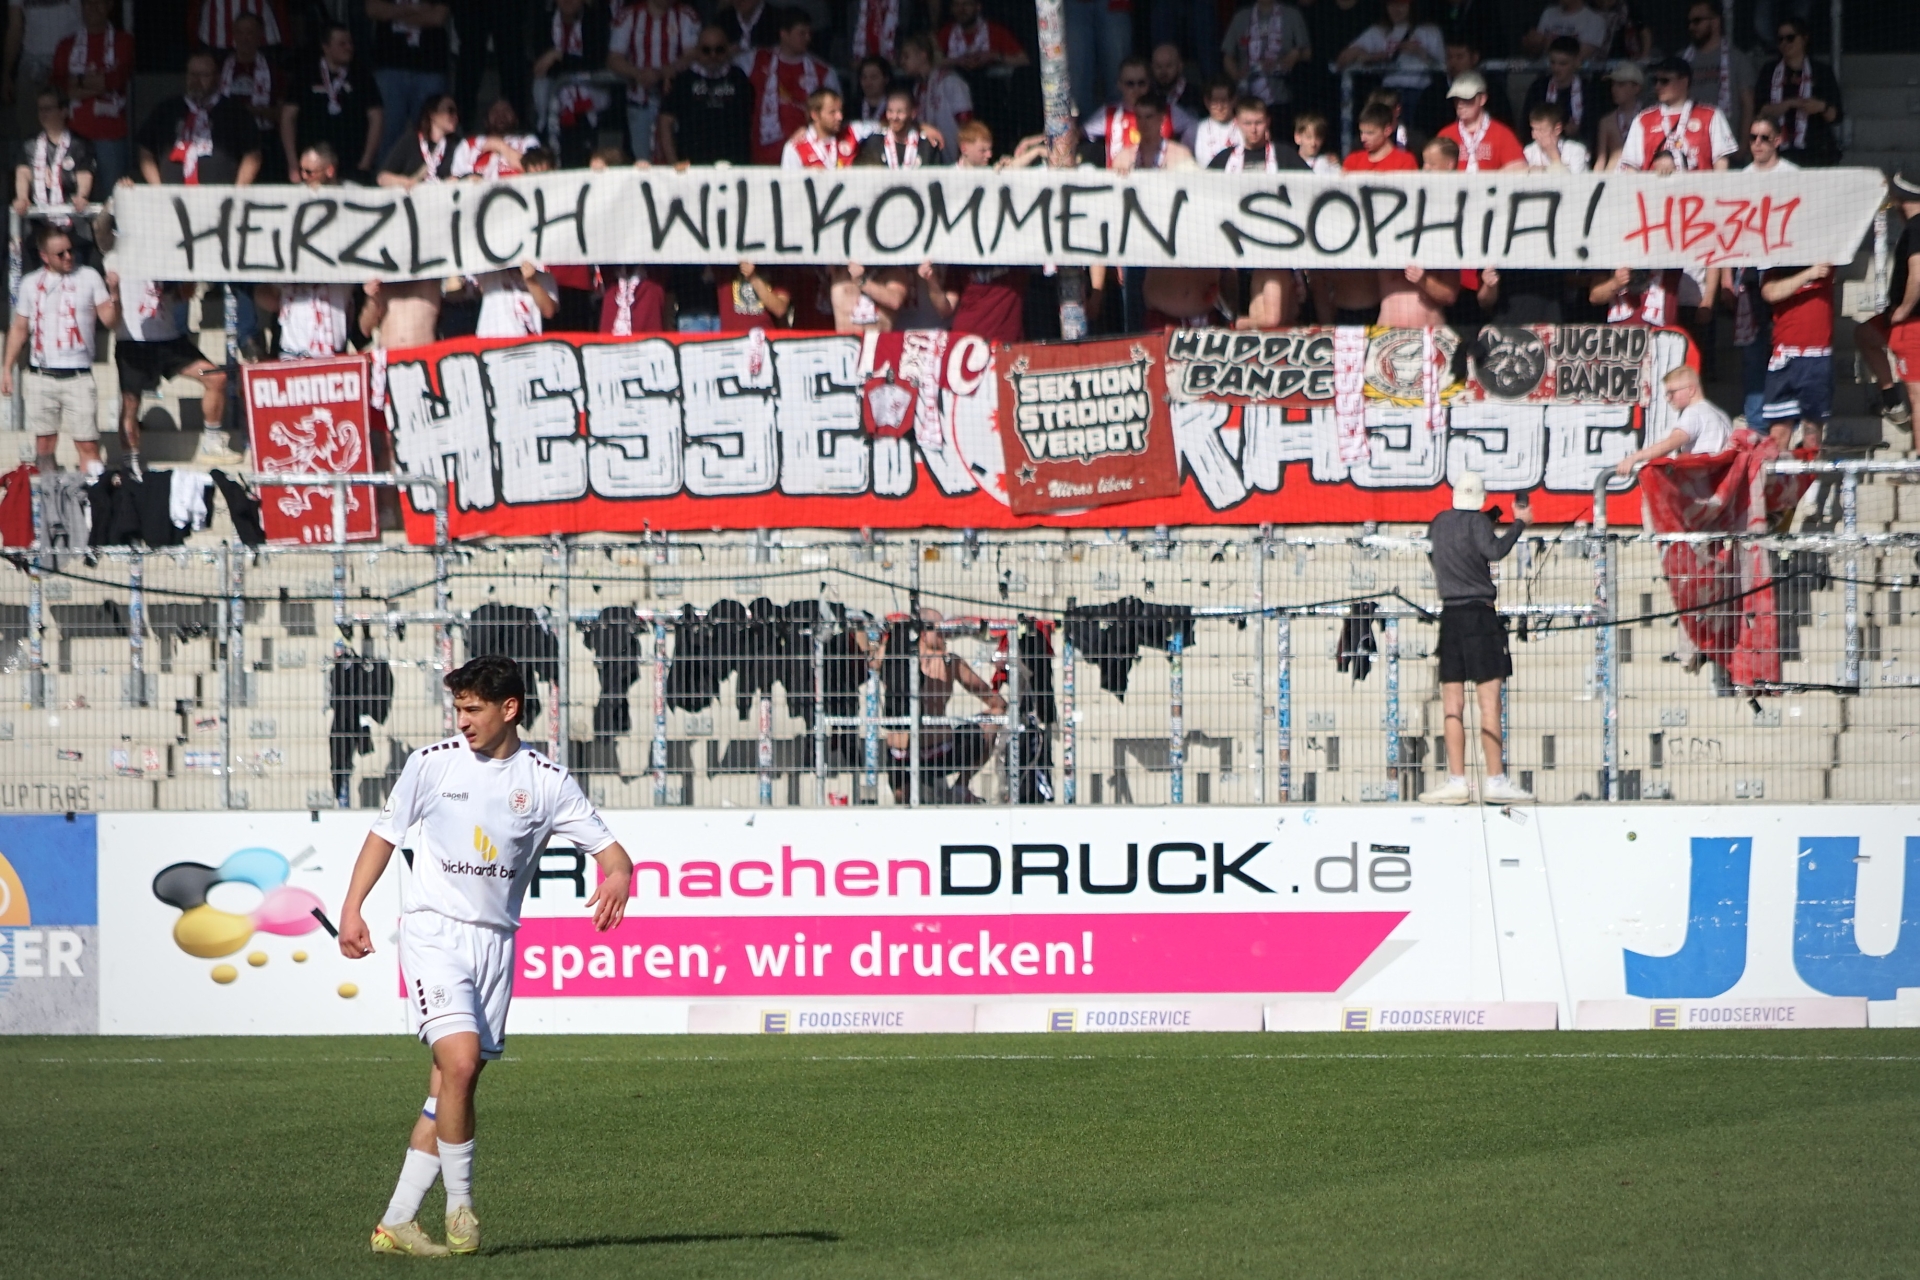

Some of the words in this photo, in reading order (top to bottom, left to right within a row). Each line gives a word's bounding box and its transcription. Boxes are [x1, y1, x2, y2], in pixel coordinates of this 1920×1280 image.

[1552, 327, 1647, 359] JUGEND
[1018, 364, 1144, 403] SEKTION
[1188, 364, 1335, 398] BANDE
[1558, 365, 1640, 398] BANDE
[1017, 393, 1148, 431] STADION
[1024, 422, 1146, 459] VERBOT
[441, 791, 469, 800] capelli
[523, 943, 727, 990] sparen,
[746, 933, 831, 977] wir
[850, 930, 1096, 977] drucken!
[798, 1011, 904, 1027] FOODSERVICE
[1085, 1010, 1192, 1026] FOODSERVICE
[1380, 1009, 1485, 1025] FOODSERVICE
[1689, 1006, 1795, 1022] FOODSERVICE
